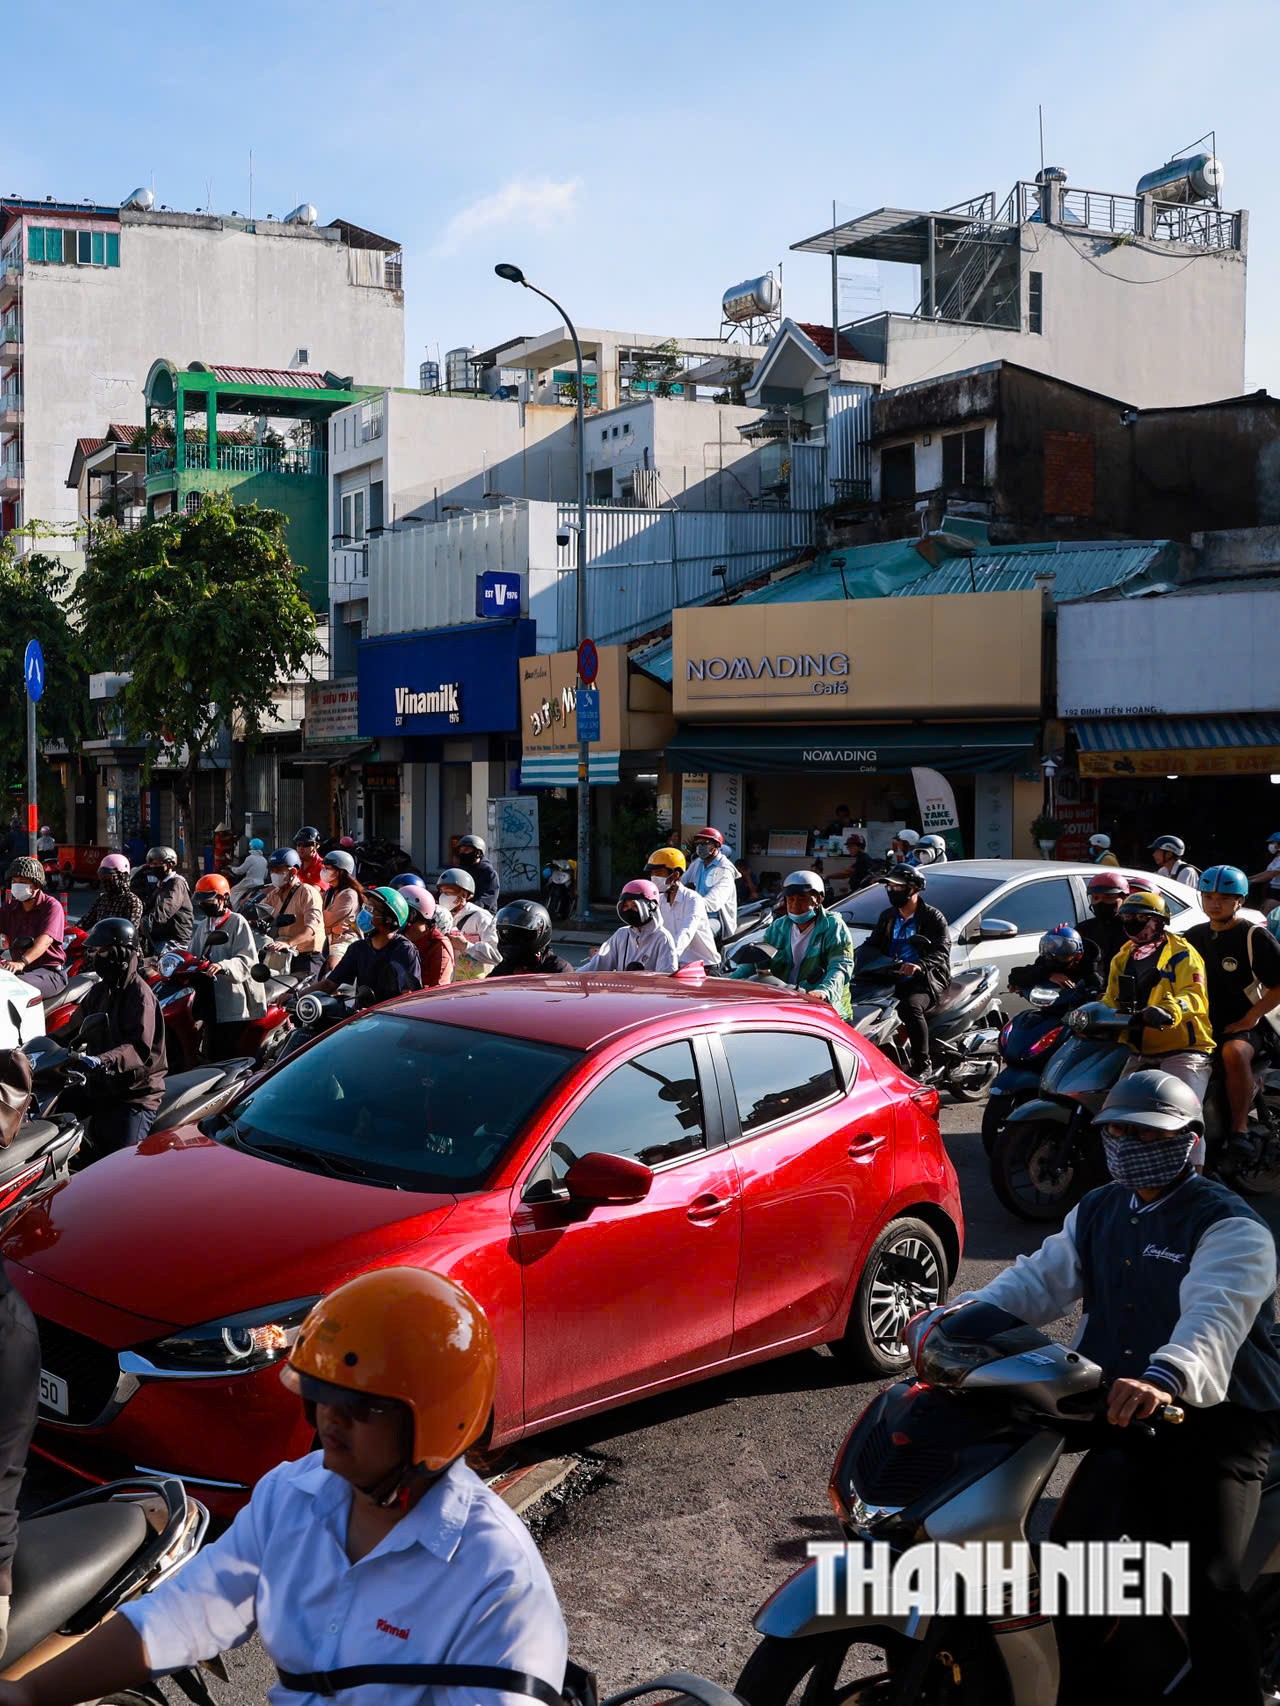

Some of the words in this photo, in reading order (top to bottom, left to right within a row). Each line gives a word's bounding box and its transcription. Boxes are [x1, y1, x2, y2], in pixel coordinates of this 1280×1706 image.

[485, 589, 493, 598] EST
[494, 583, 507, 605] V
[506, 591, 518, 599] 1976
[687, 652, 849, 681] NOMADING
[812, 680, 849, 695] Café
[394, 683, 458, 714] Vinamilk
[449, 713, 459, 723] 1976
[803, 750, 877, 761] NOMADING
[923, 810, 950, 819] TAKE
[924, 818, 954, 827] AWAY
[40, 1376, 58, 1405] 50
[376, 1618, 411, 1640] Rinnai
